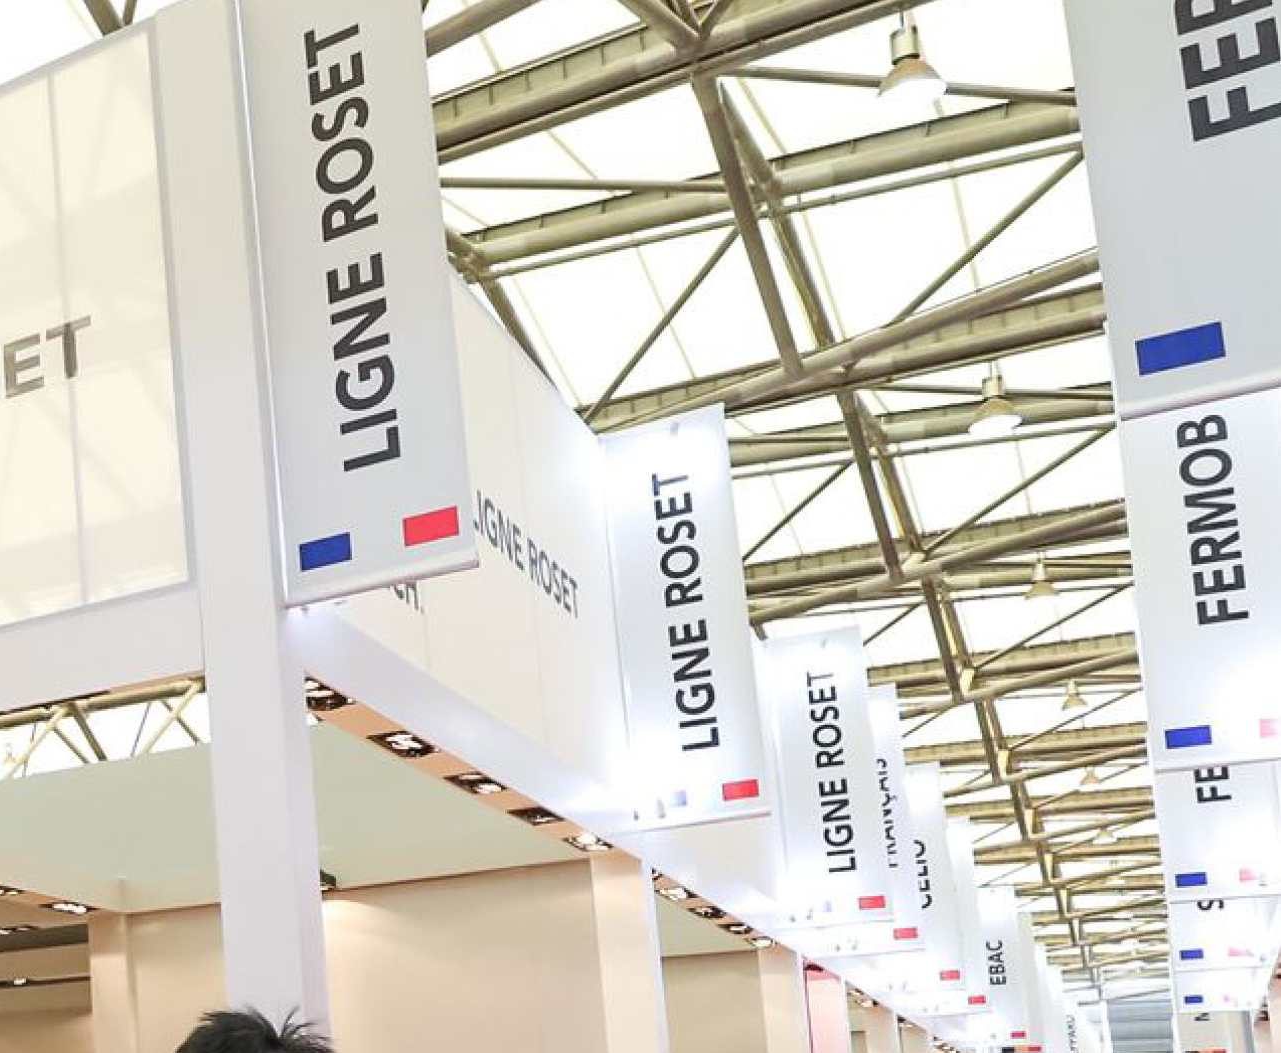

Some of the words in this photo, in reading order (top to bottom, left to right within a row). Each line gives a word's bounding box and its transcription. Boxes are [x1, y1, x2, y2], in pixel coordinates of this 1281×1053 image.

[304, 22, 379, 243] ROSET
[325, 252, 402, 472] LIGNE
[473, 489, 525, 571] IGNE
[527, 537, 578, 619] ROSET
[652, 473, 706, 609] ROSET
[1177, 413, 1249, 626] FERMOB
[668, 617, 719, 753] LIGNE
[806, 671, 846, 769] ROSET
[819, 777, 857, 873] LIGNE
[987, 939, 1007, 986] EBAC
